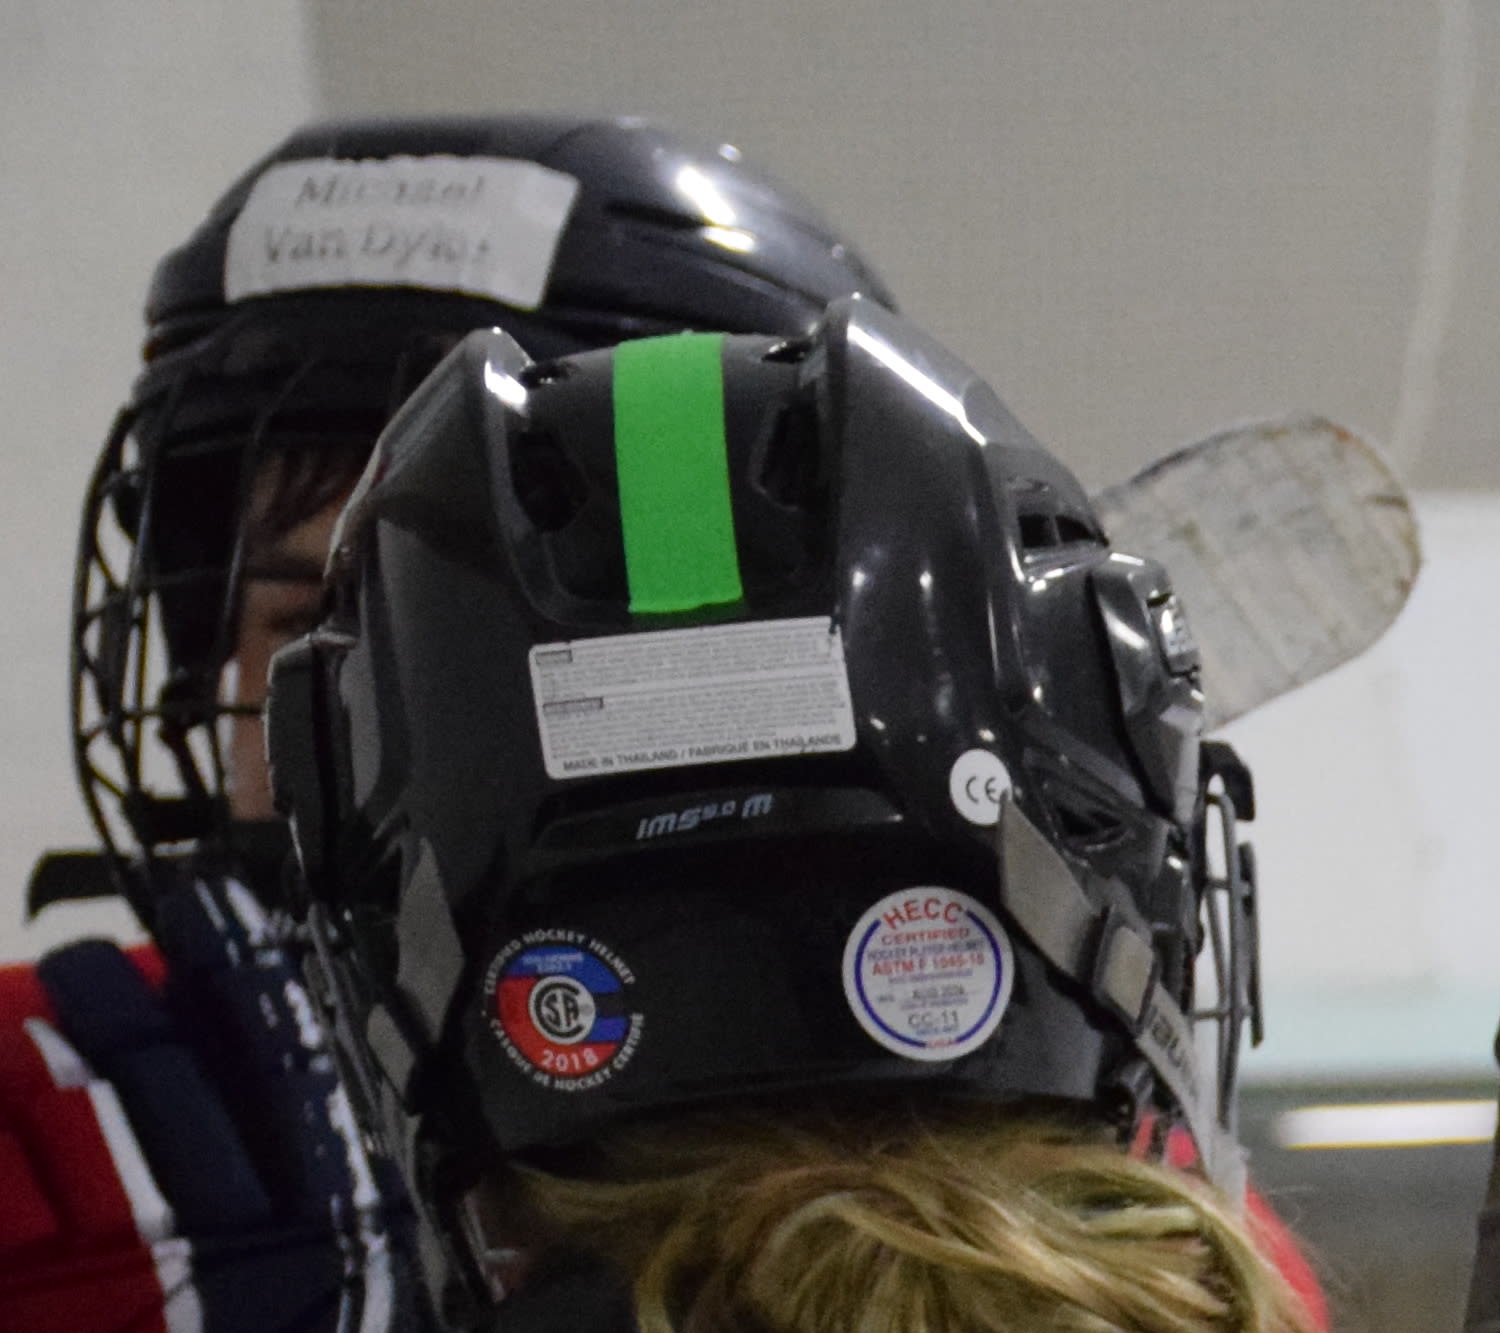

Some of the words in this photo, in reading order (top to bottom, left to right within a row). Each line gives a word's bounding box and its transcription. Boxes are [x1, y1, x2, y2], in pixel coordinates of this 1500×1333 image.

[882, 897, 964, 930] HECC
[522, 928, 586, 945] HOCKEY
[881, 927, 970, 946] CERTIFIED
[541, 1048, 599, 1073] 2018
